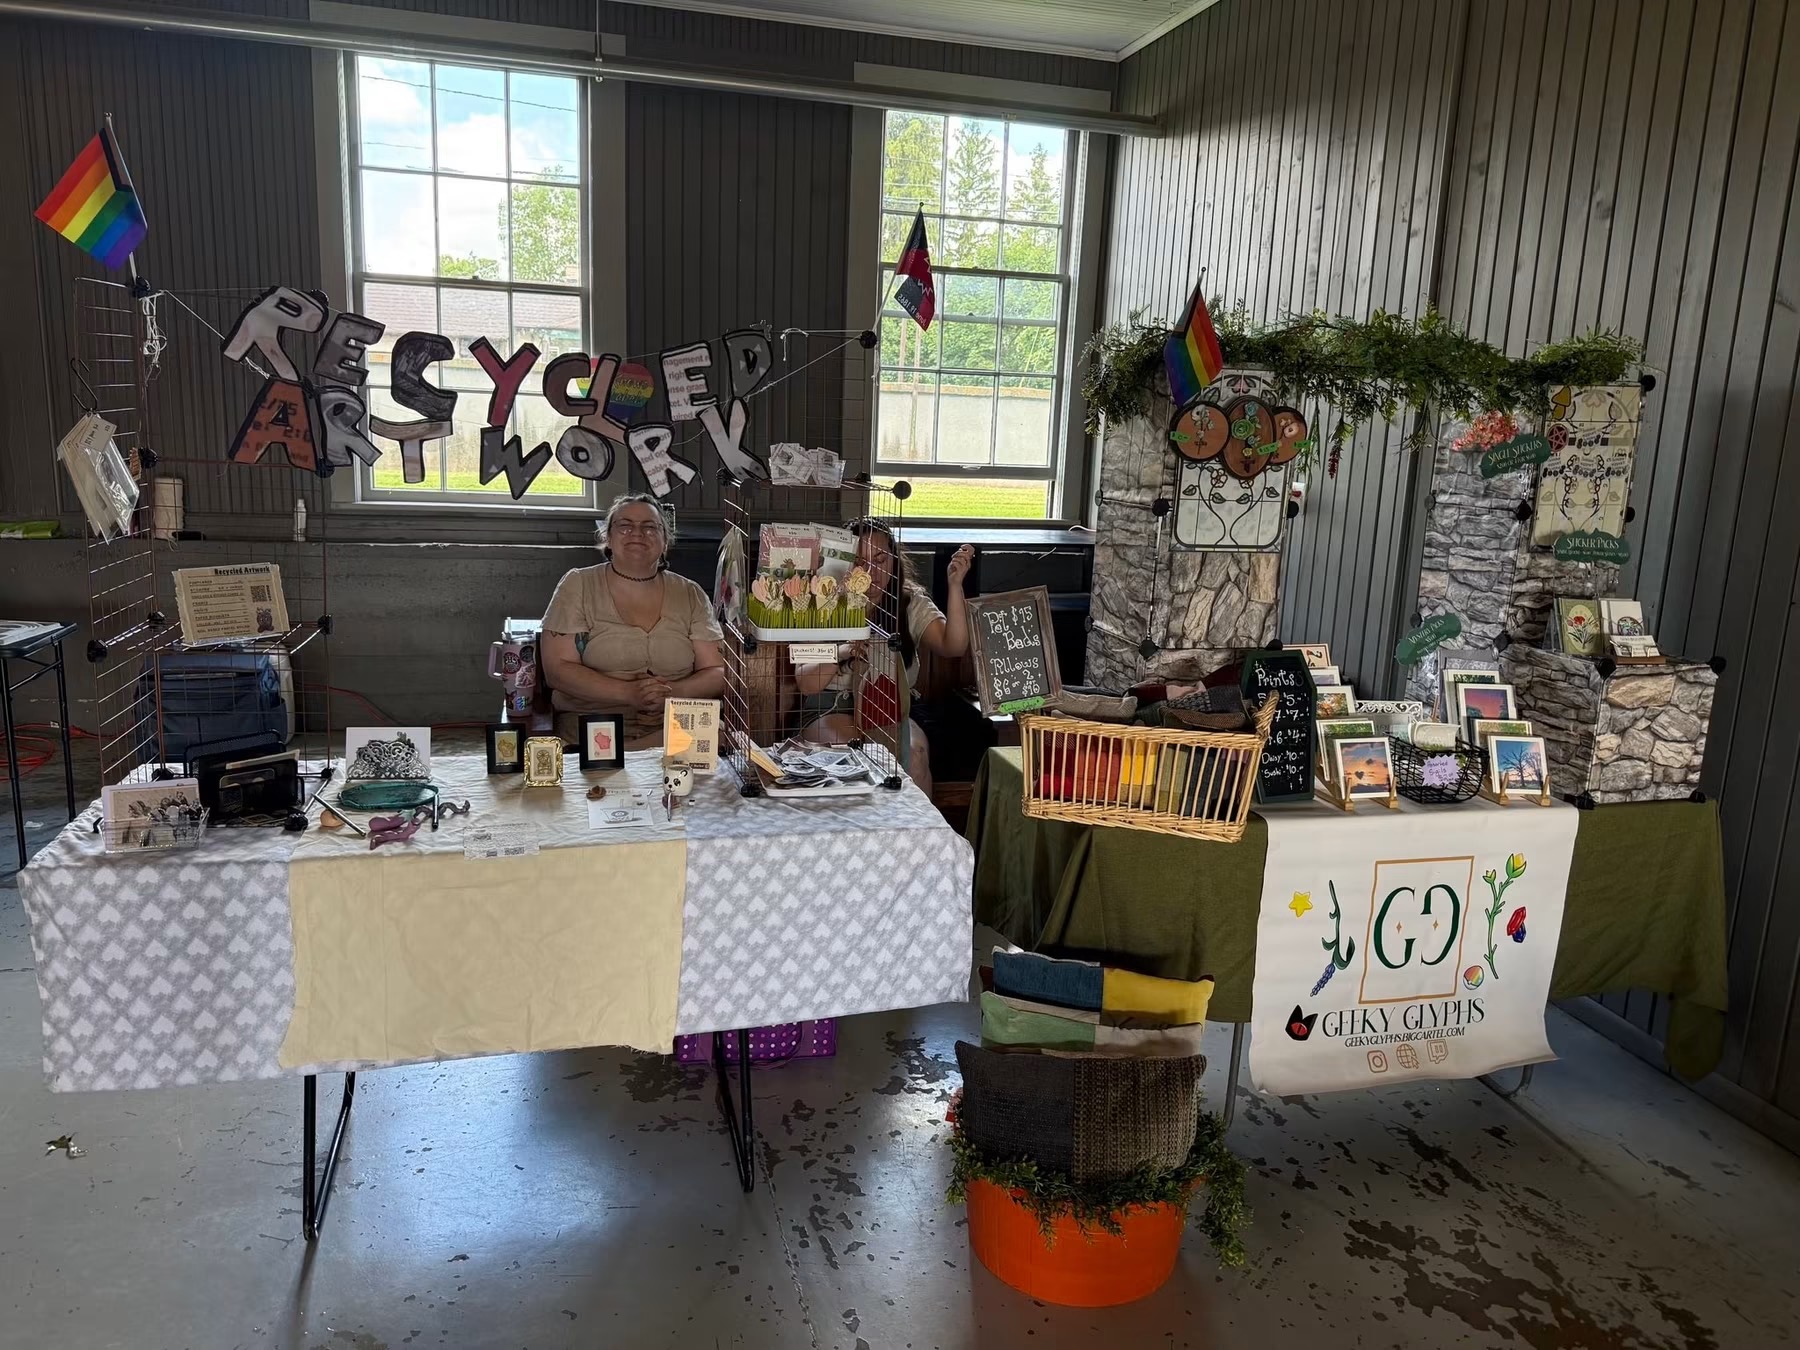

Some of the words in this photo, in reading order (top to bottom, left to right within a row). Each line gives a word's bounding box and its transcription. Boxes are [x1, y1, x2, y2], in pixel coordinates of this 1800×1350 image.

[221, 286, 773, 446] RECYCLED
[214, 567, 243, 577] Recycled
[244, 565, 270, 574] Artwork
[983, 610, 1009, 633] Pet
[1011, 605, 1033, 626] $15
[1003, 626, 1041, 650] Beds
[993, 677, 1011, 700] $6
[1255, 667, 1295, 687] Prints
[1322, 1006, 1396, 1037] GEEKY
[1403, 998, 1485, 1031] GLYPHS
[1344, 1027, 1466, 1048] GEEKYGLYPHS.BIGCARTEL.COM
